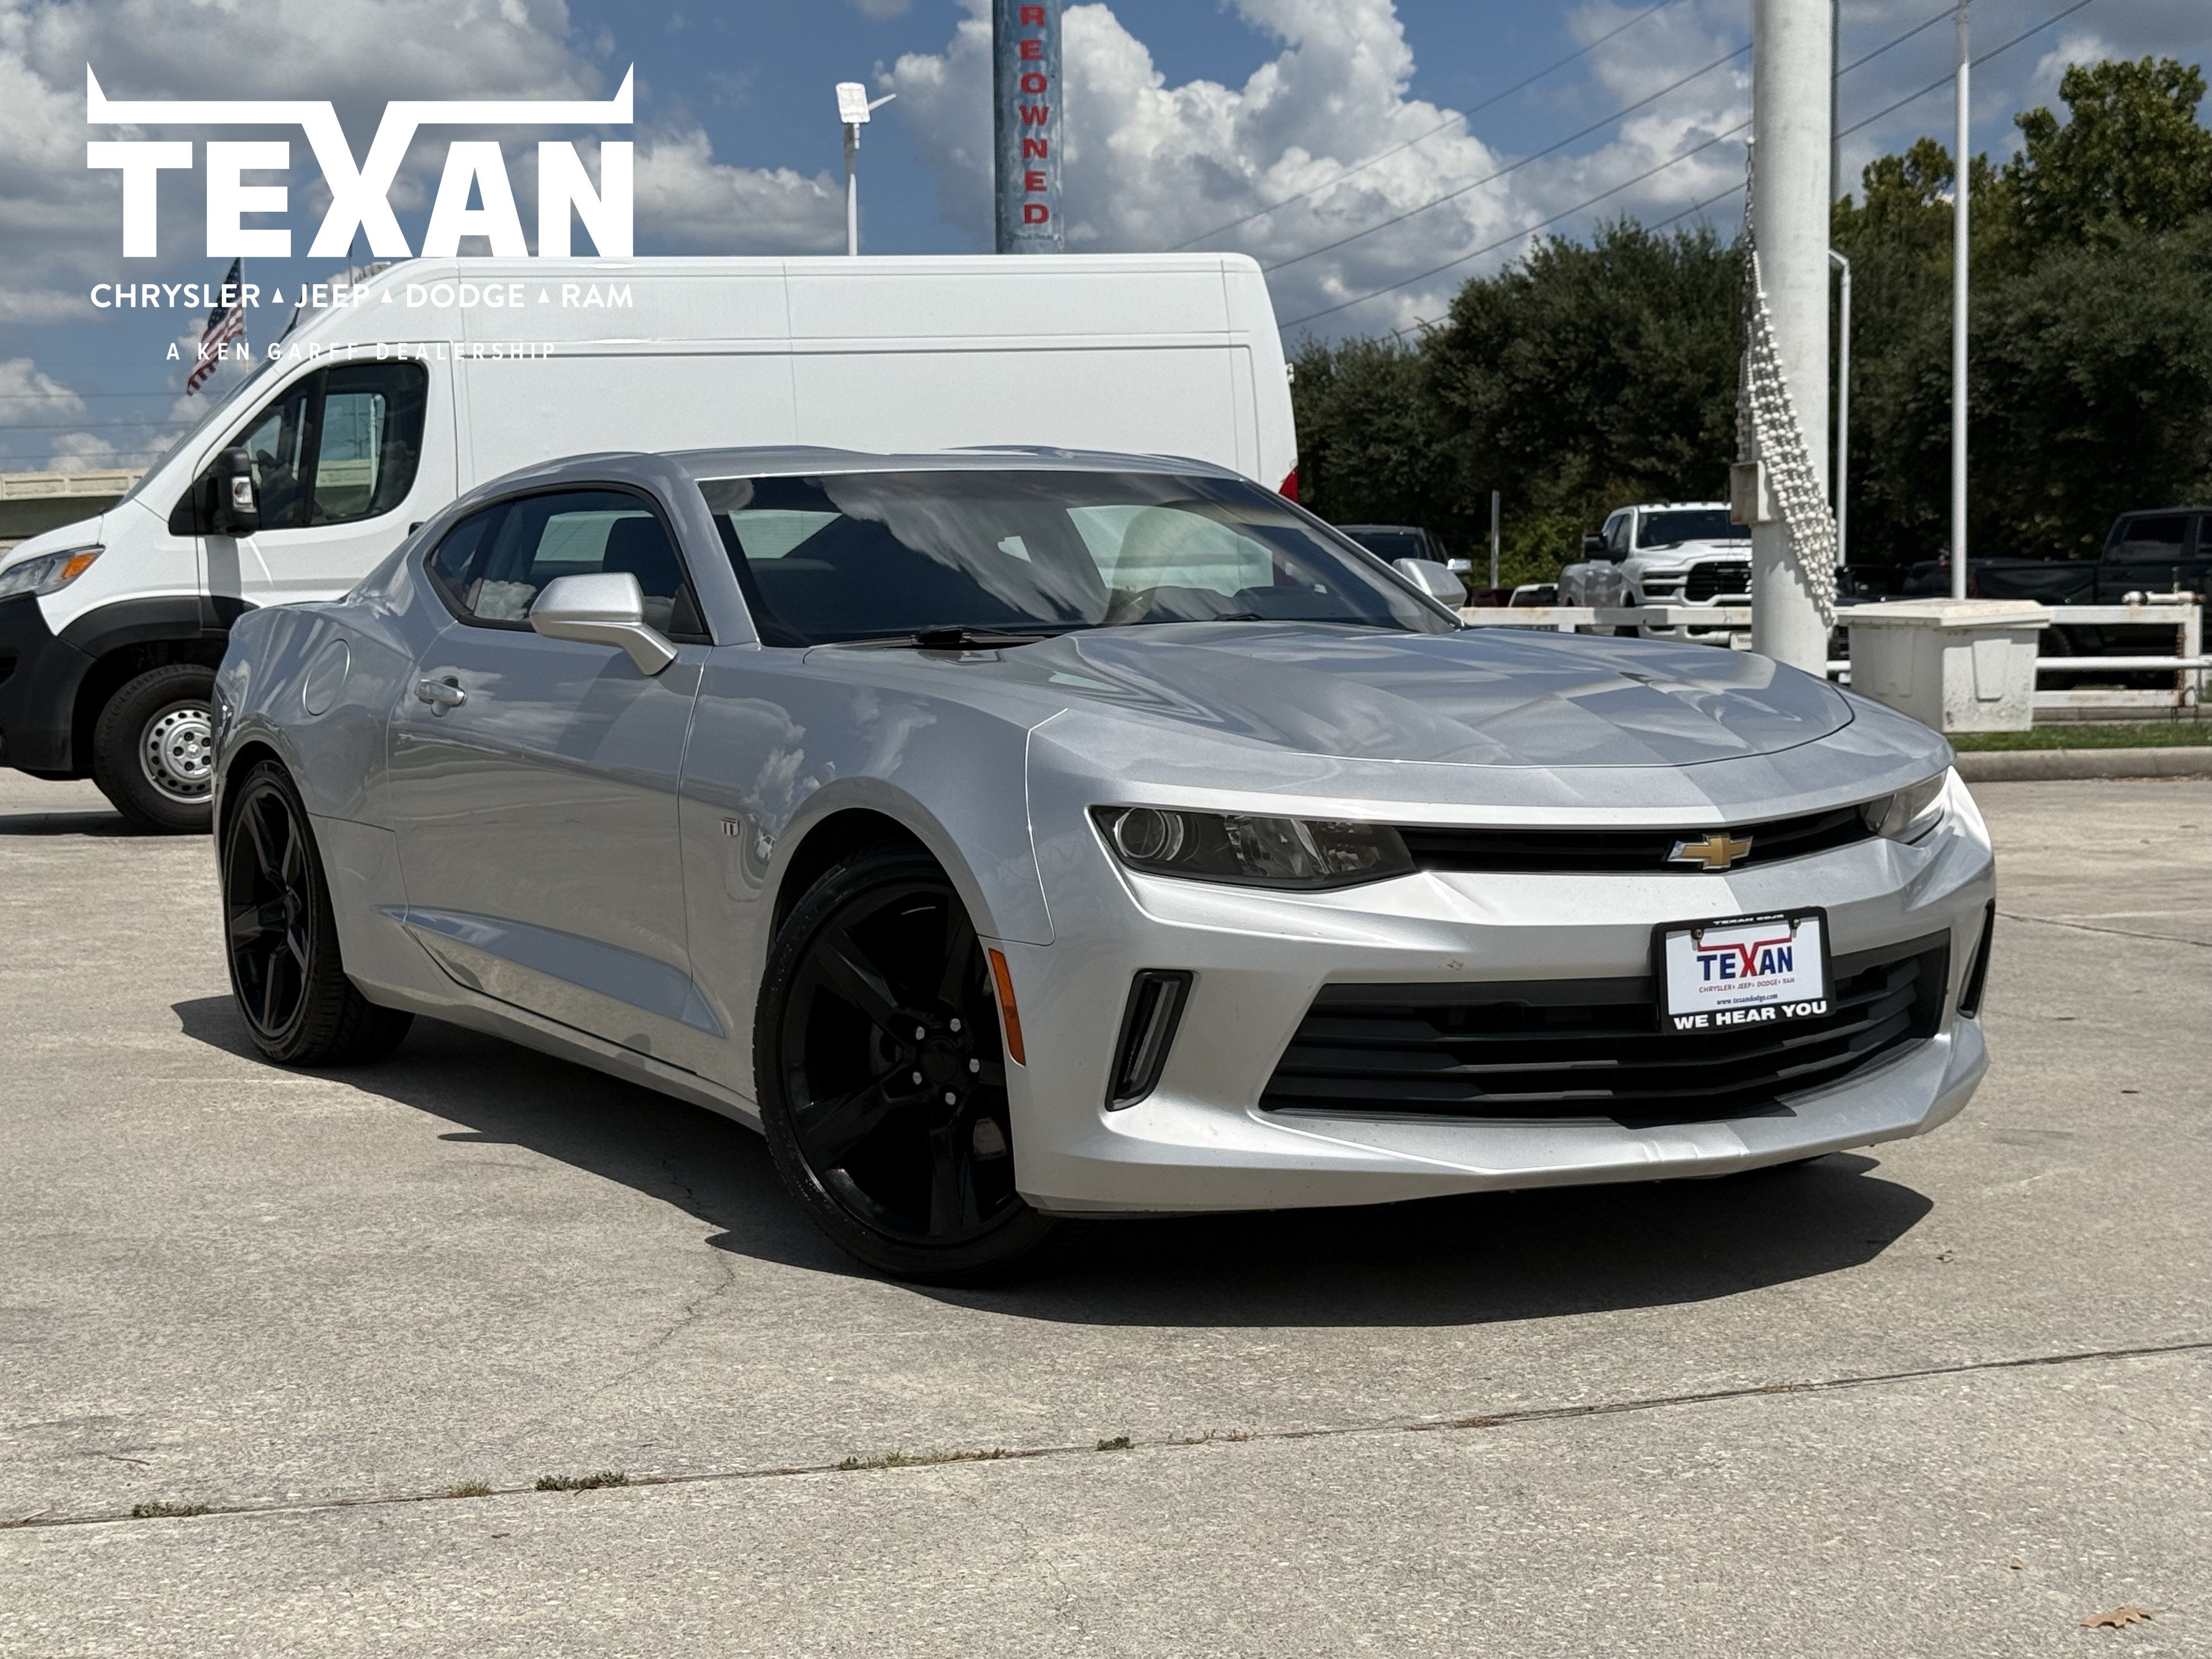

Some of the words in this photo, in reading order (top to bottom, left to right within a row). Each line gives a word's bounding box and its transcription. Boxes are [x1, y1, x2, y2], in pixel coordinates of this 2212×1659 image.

[1696, 941, 1793, 981] TEXAN
[1699, 984, 1732, 993] CHRYSLER
[1757, 979, 1778, 988] DODGE
[1673, 1014, 1709, 1030] WE
[1716, 1007, 1776, 1025] HEAR
[1781, 1000, 1827, 1018] YOU
